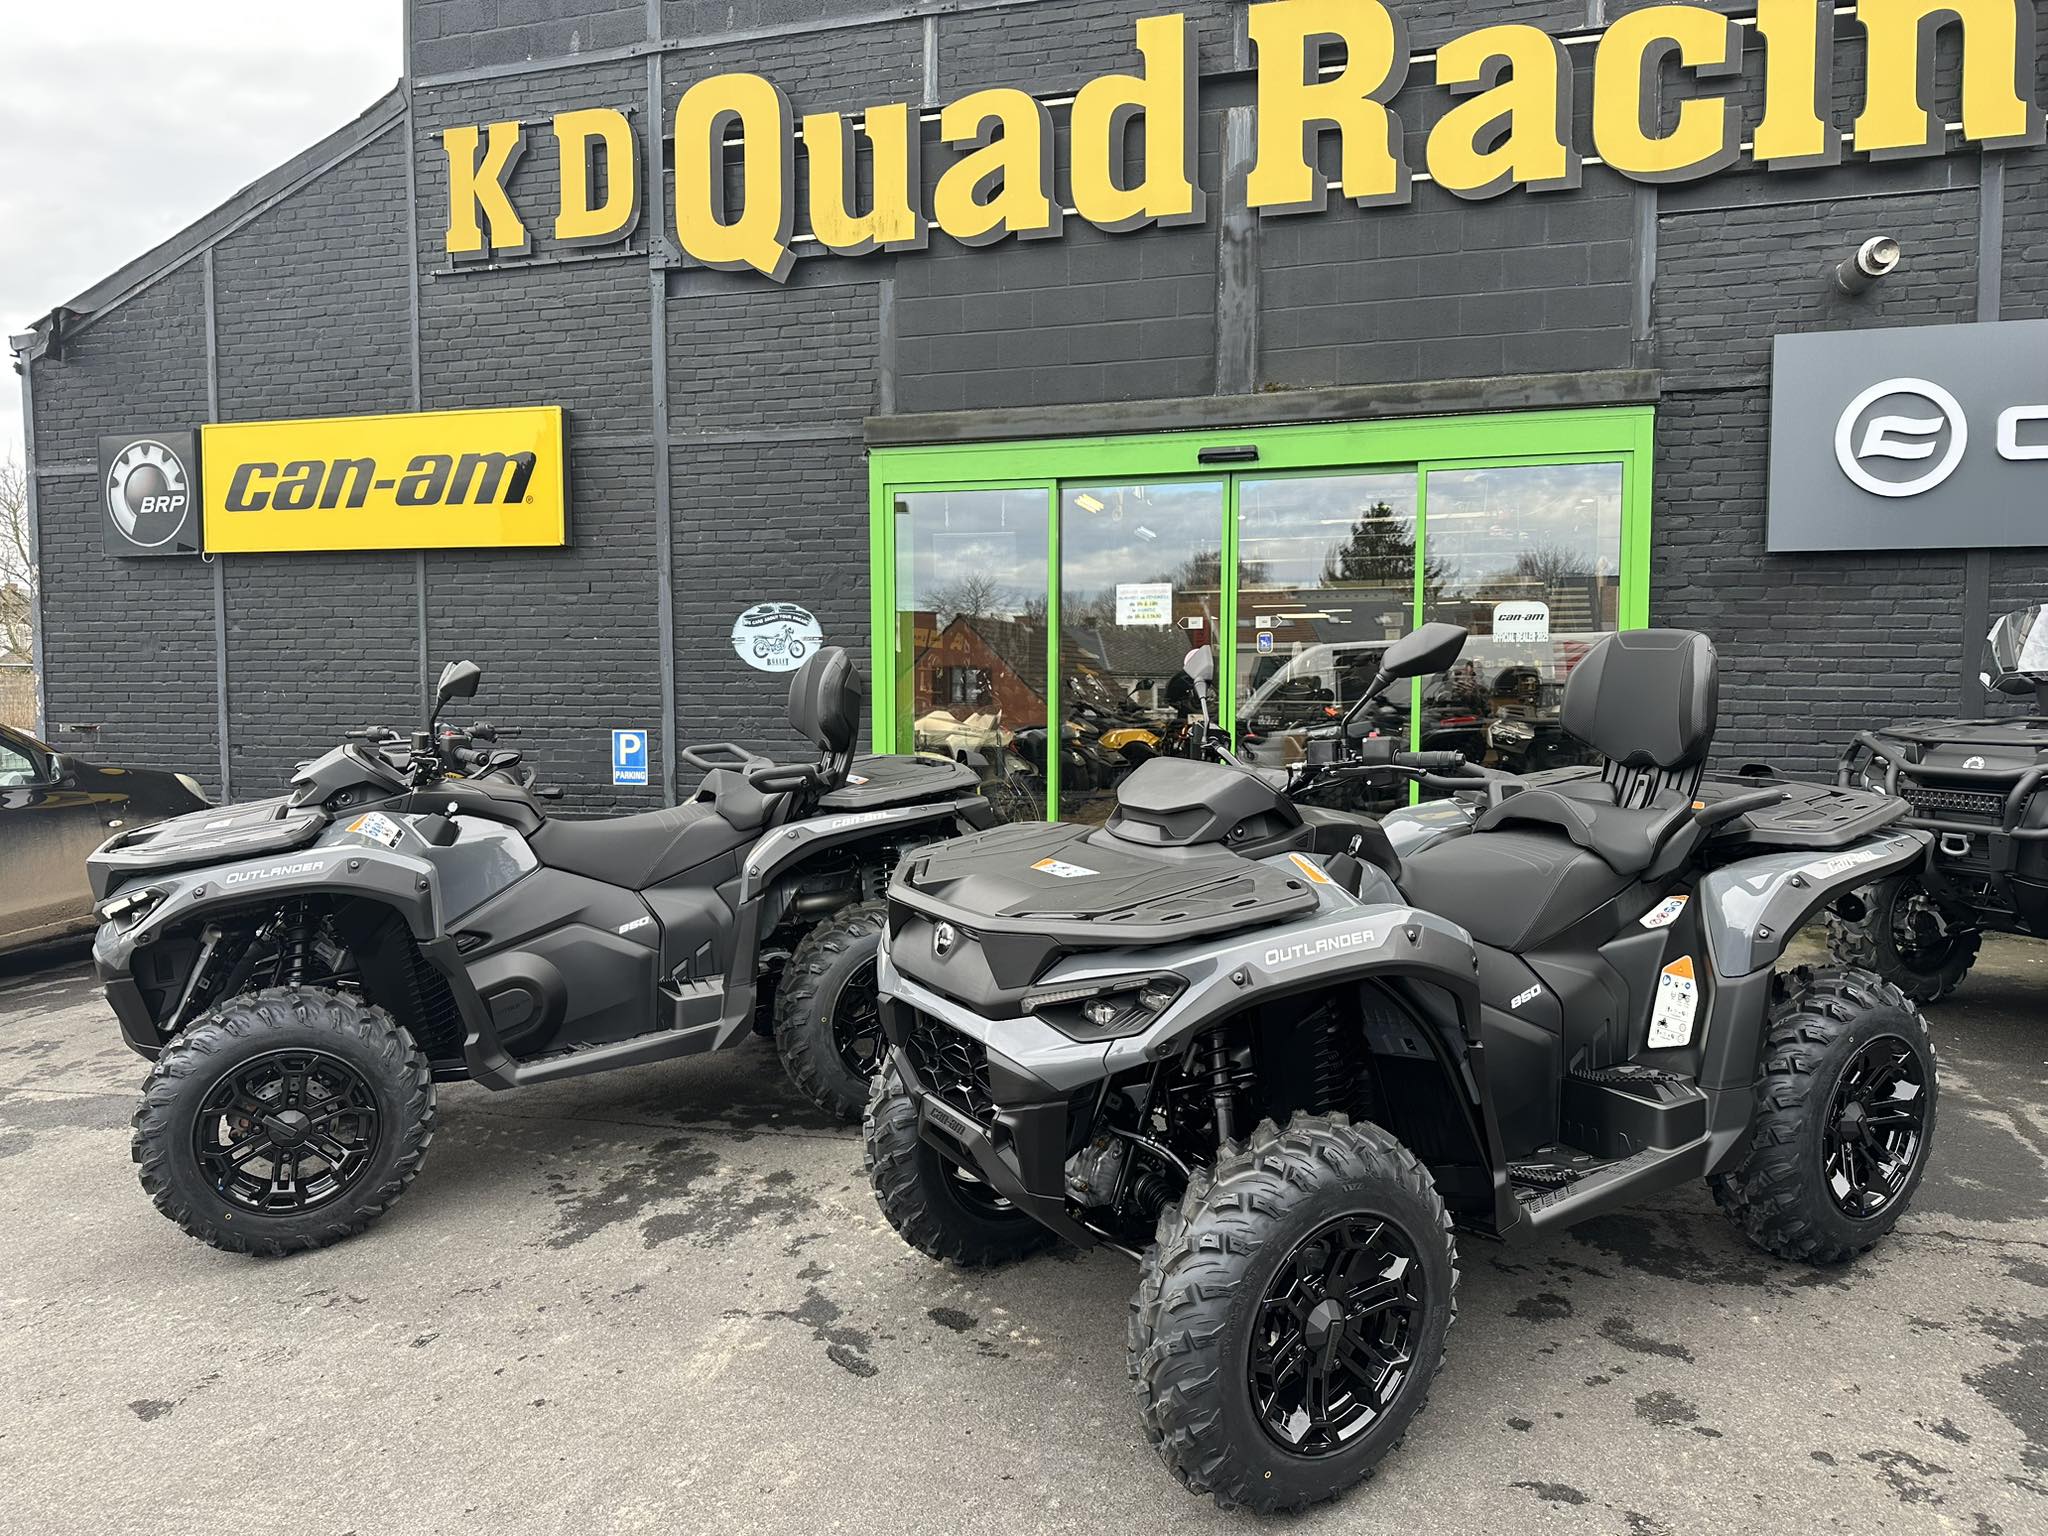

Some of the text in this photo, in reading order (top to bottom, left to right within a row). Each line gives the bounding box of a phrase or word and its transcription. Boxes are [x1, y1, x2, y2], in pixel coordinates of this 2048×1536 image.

[674, 13, 1200, 280] Quad
[224, 451, 537, 512] can-am
[140, 495, 185, 513] BRP
[1497, 613, 1545, 621] can-am
[620, 733, 641, 765] P
[615, 770, 646, 780] PARKING
[226, 861, 324, 884] OUTLANDER
[1265, 929, 1375, 966] OUTLANDER
[1510, 983, 1542, 1009] 850
